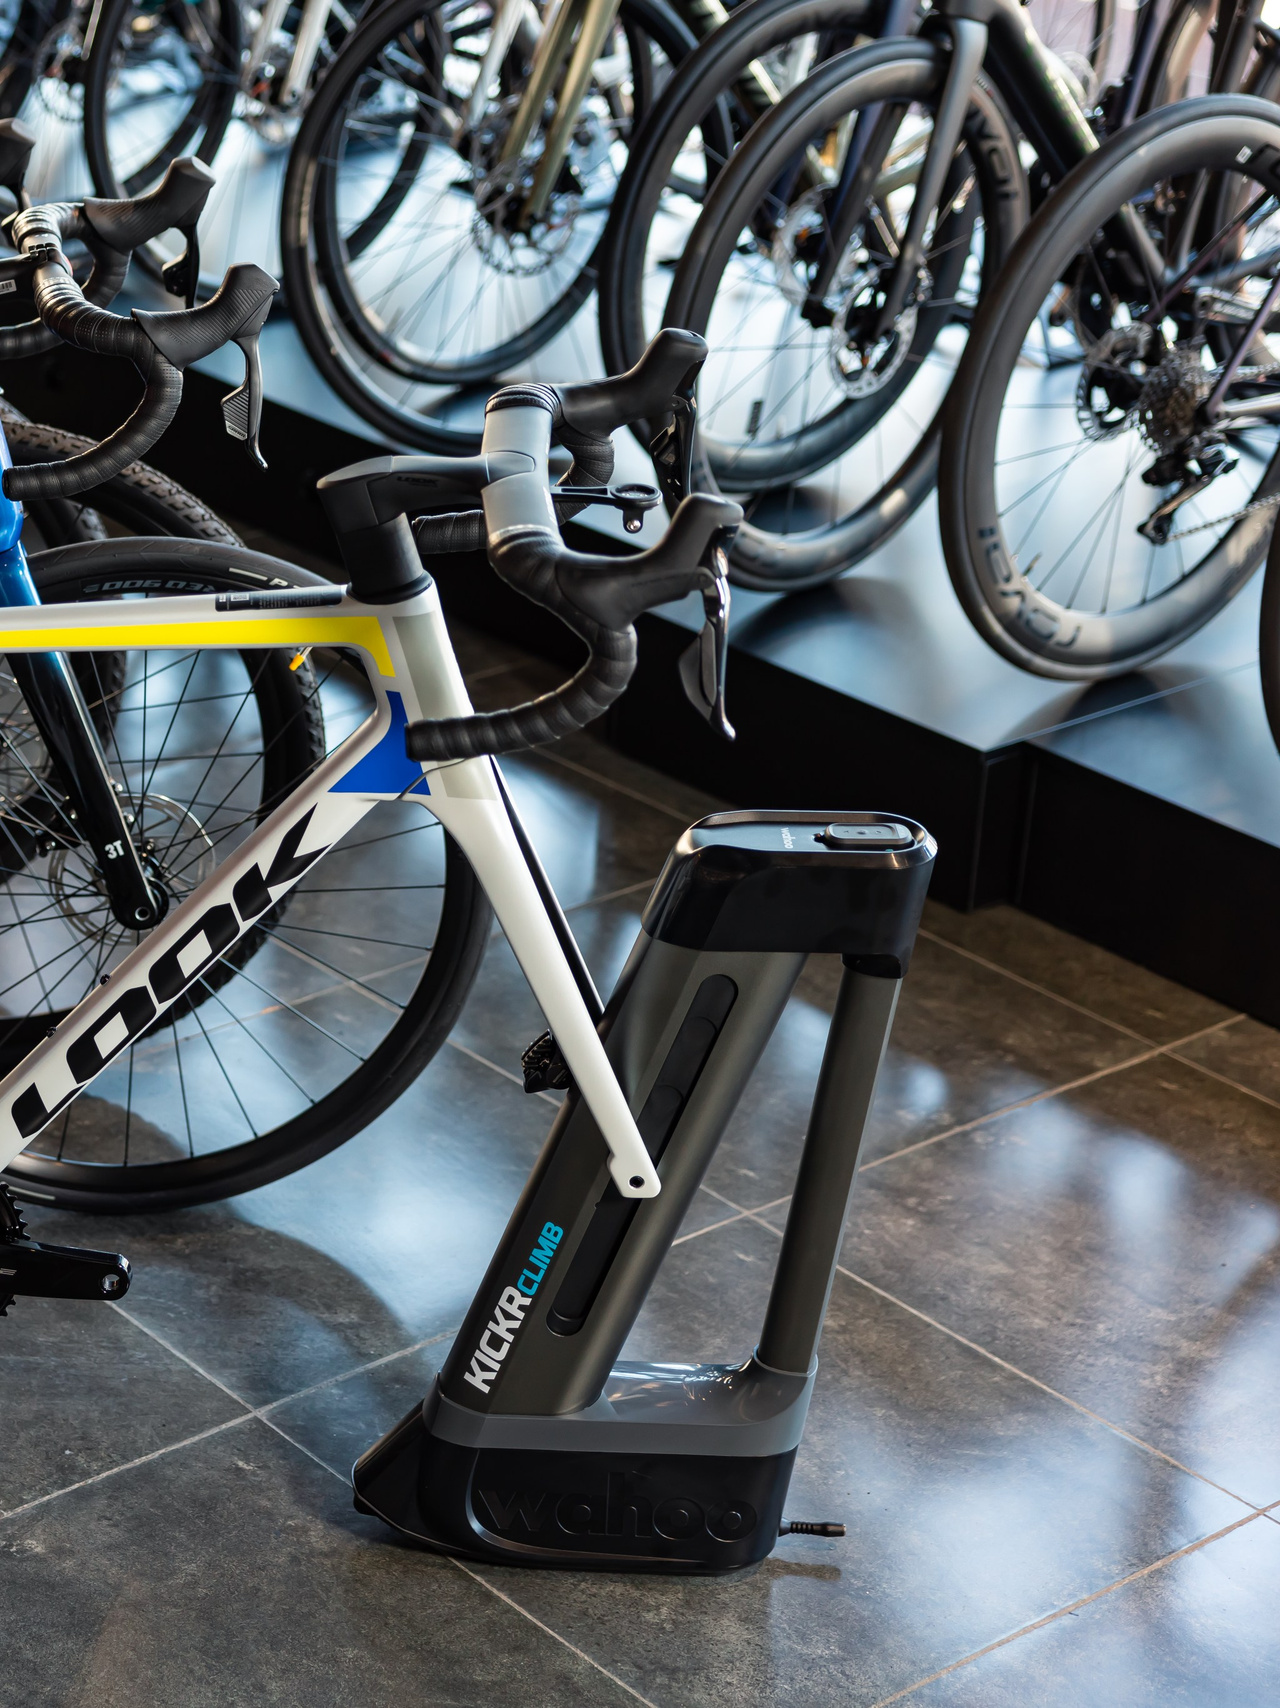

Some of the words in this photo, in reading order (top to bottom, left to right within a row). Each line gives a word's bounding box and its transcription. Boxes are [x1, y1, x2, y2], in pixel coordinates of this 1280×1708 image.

[104, 840, 125, 859] 3T
[780, 827, 796, 849] wahoo
[11, 803, 332, 1138] LOOK
[463, 1285, 532, 1394] KICKR
[516, 1221, 564, 1296] CLIMB
[478, 1472, 758, 1543] wahoo
